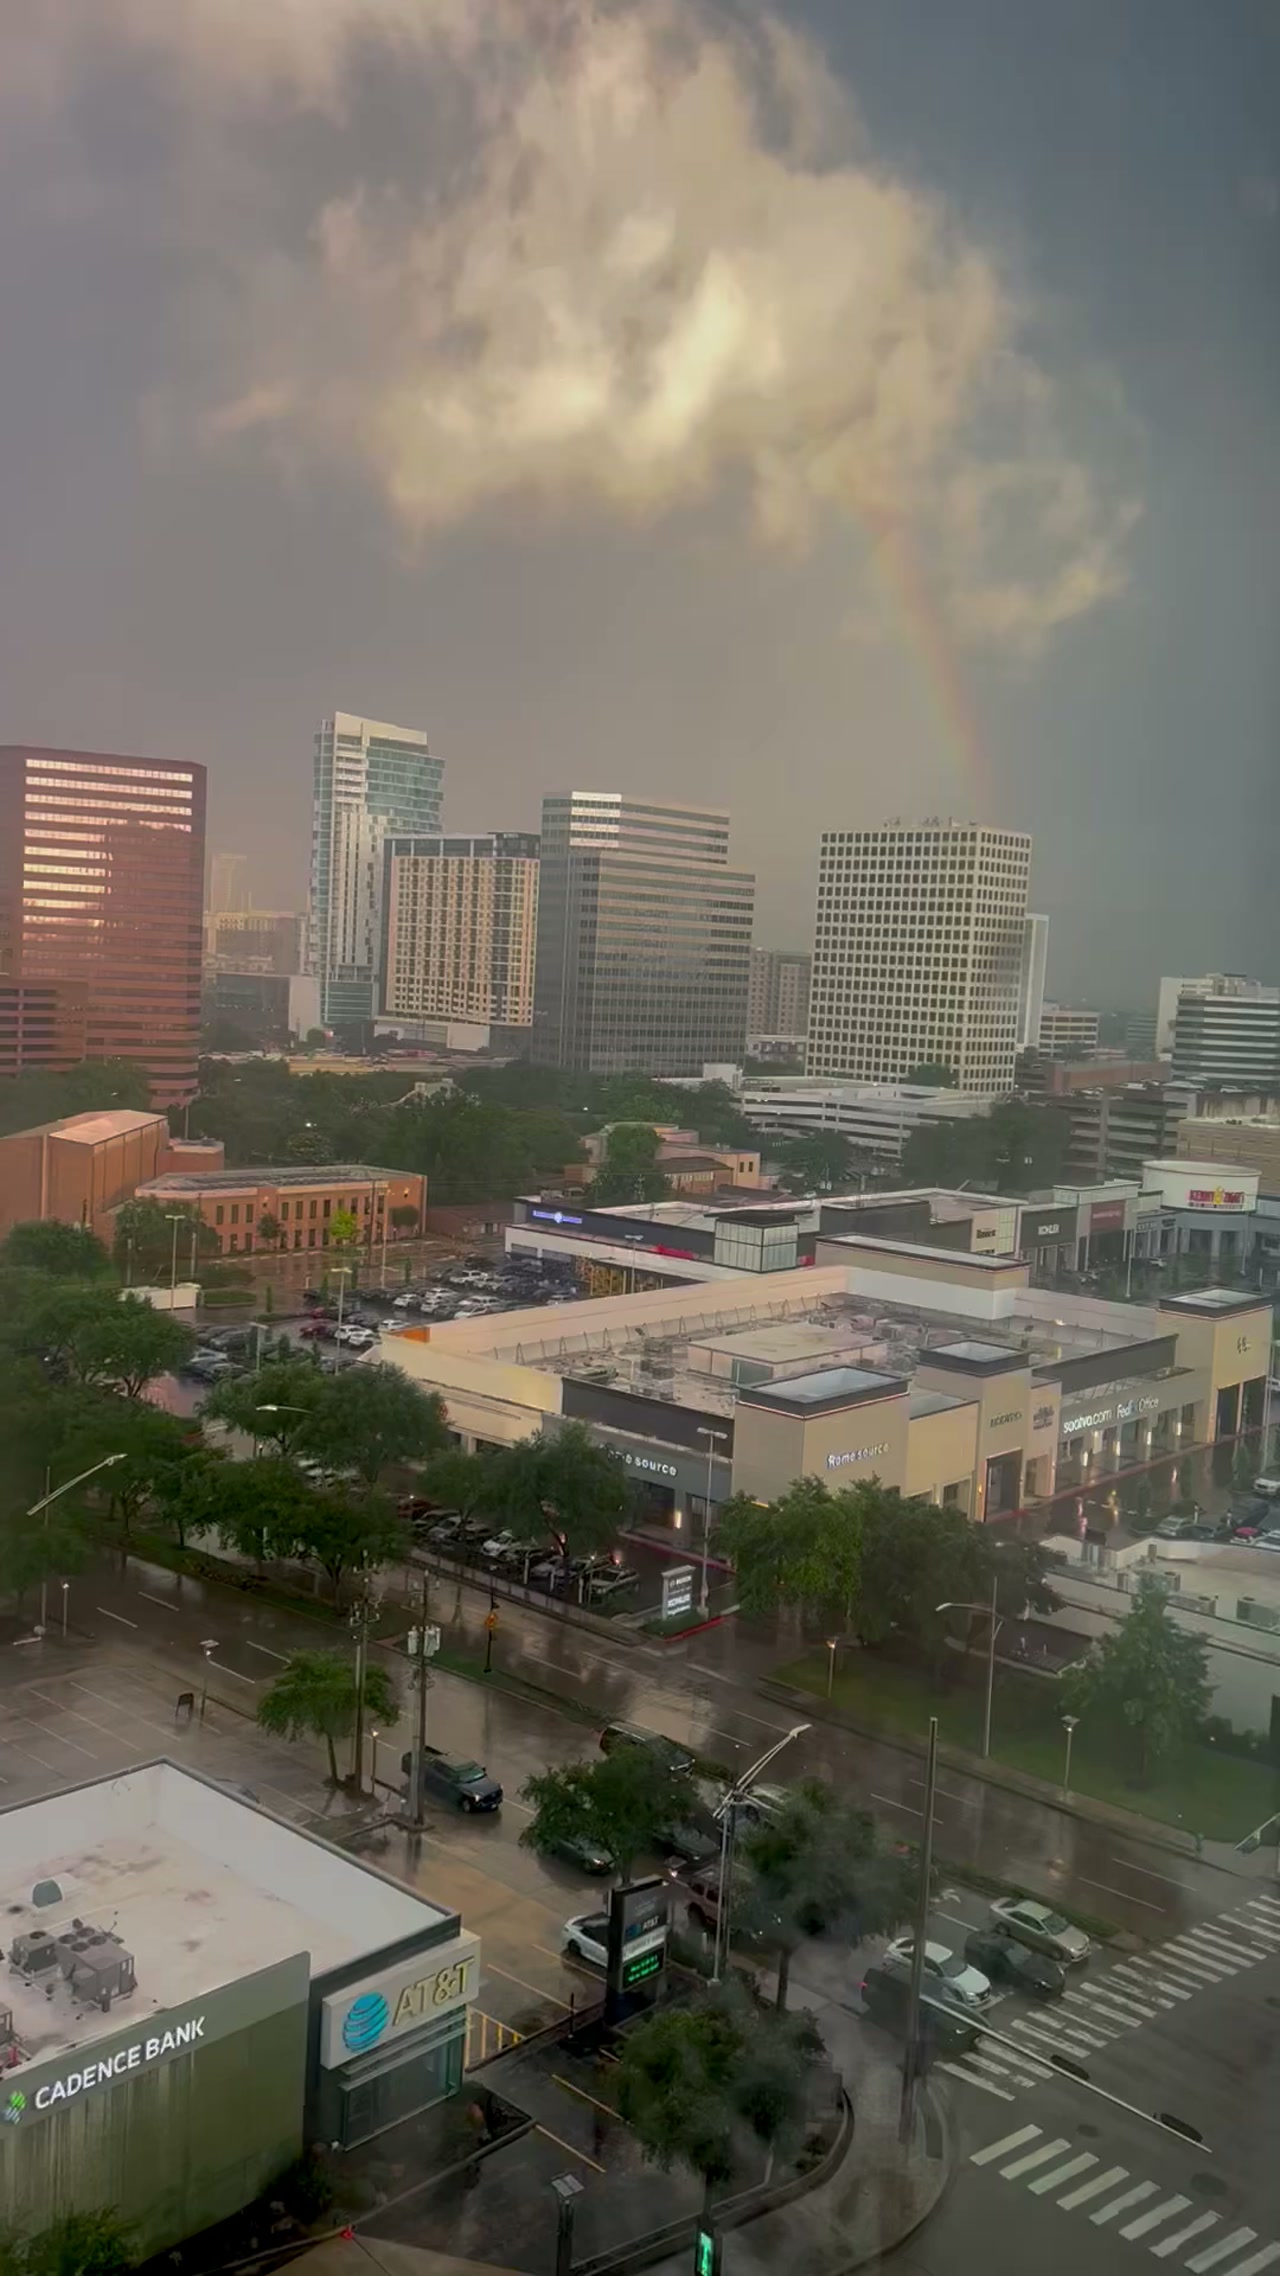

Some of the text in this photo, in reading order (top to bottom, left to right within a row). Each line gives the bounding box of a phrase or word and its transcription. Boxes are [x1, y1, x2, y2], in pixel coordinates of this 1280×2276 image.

[1063, 1408, 1112, 1433] saatva.com
[1138, 1396, 1159, 1413] Office
[634, 1456, 678, 1476] source
[392, 1955, 475, 2026] AT&T
[34, 2016, 206, 2109] CADENCE BANK
